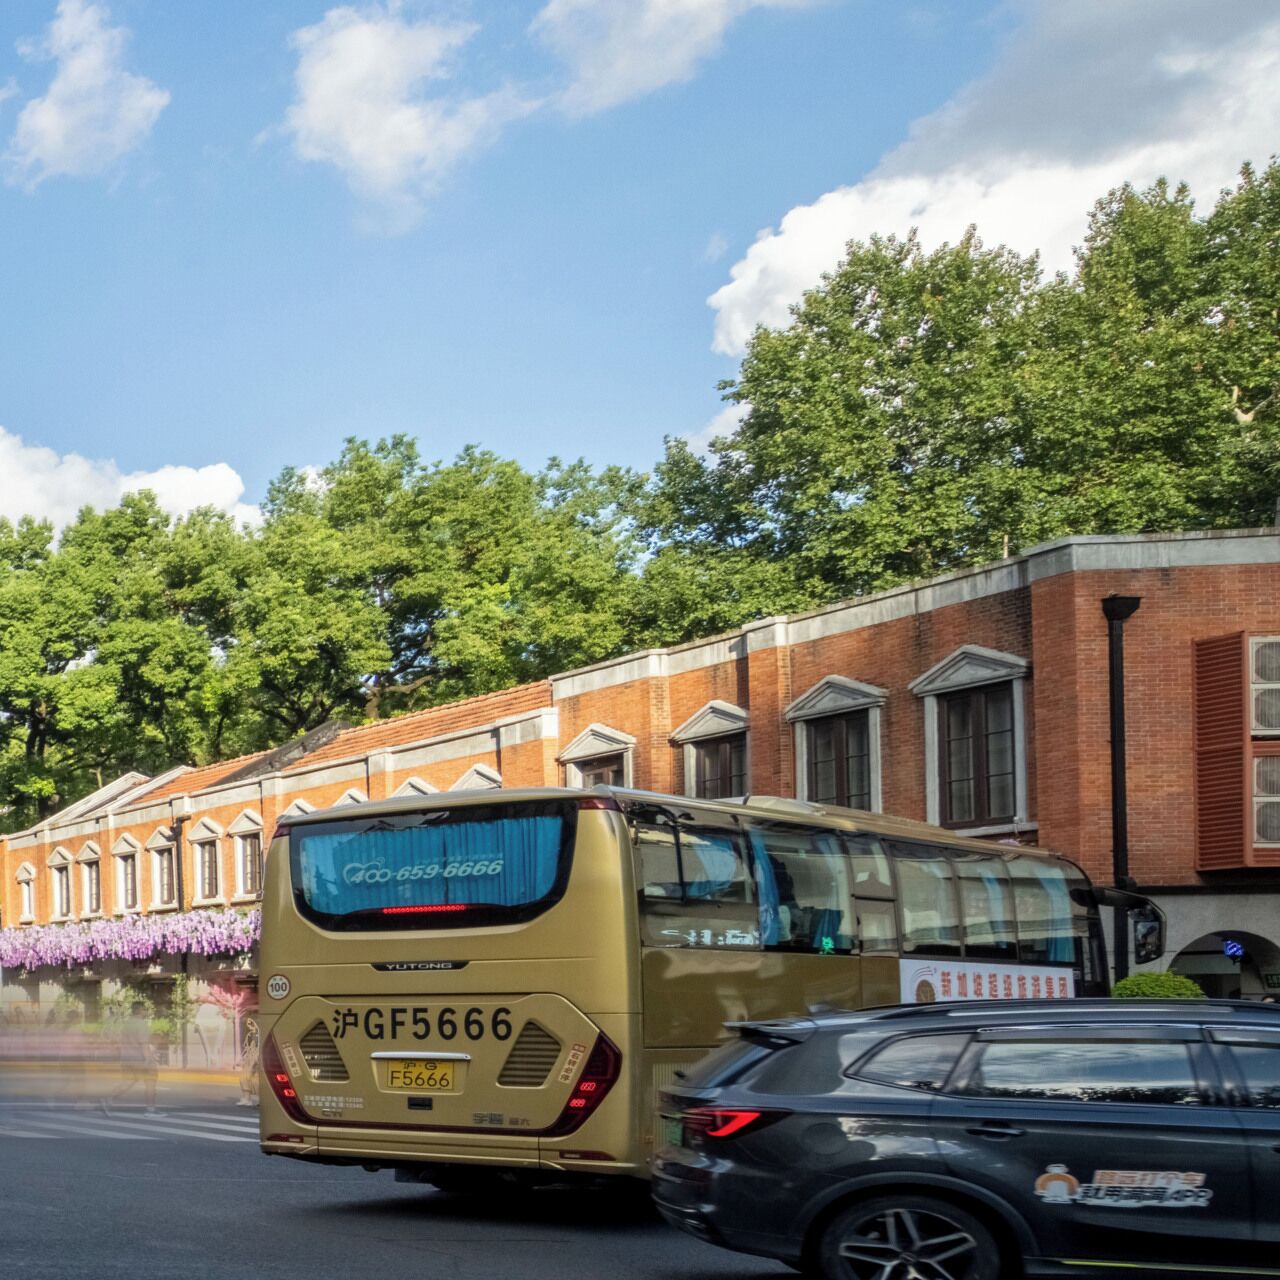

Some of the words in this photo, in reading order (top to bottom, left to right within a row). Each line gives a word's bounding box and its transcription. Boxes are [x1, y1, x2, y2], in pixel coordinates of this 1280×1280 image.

[351, 860, 505, 883] 400-659-6666
[269, 982, 288, 993] 100
[332, 1007, 513, 1041] 沪GF5666
[390, 1071, 450, 1088] F5666
